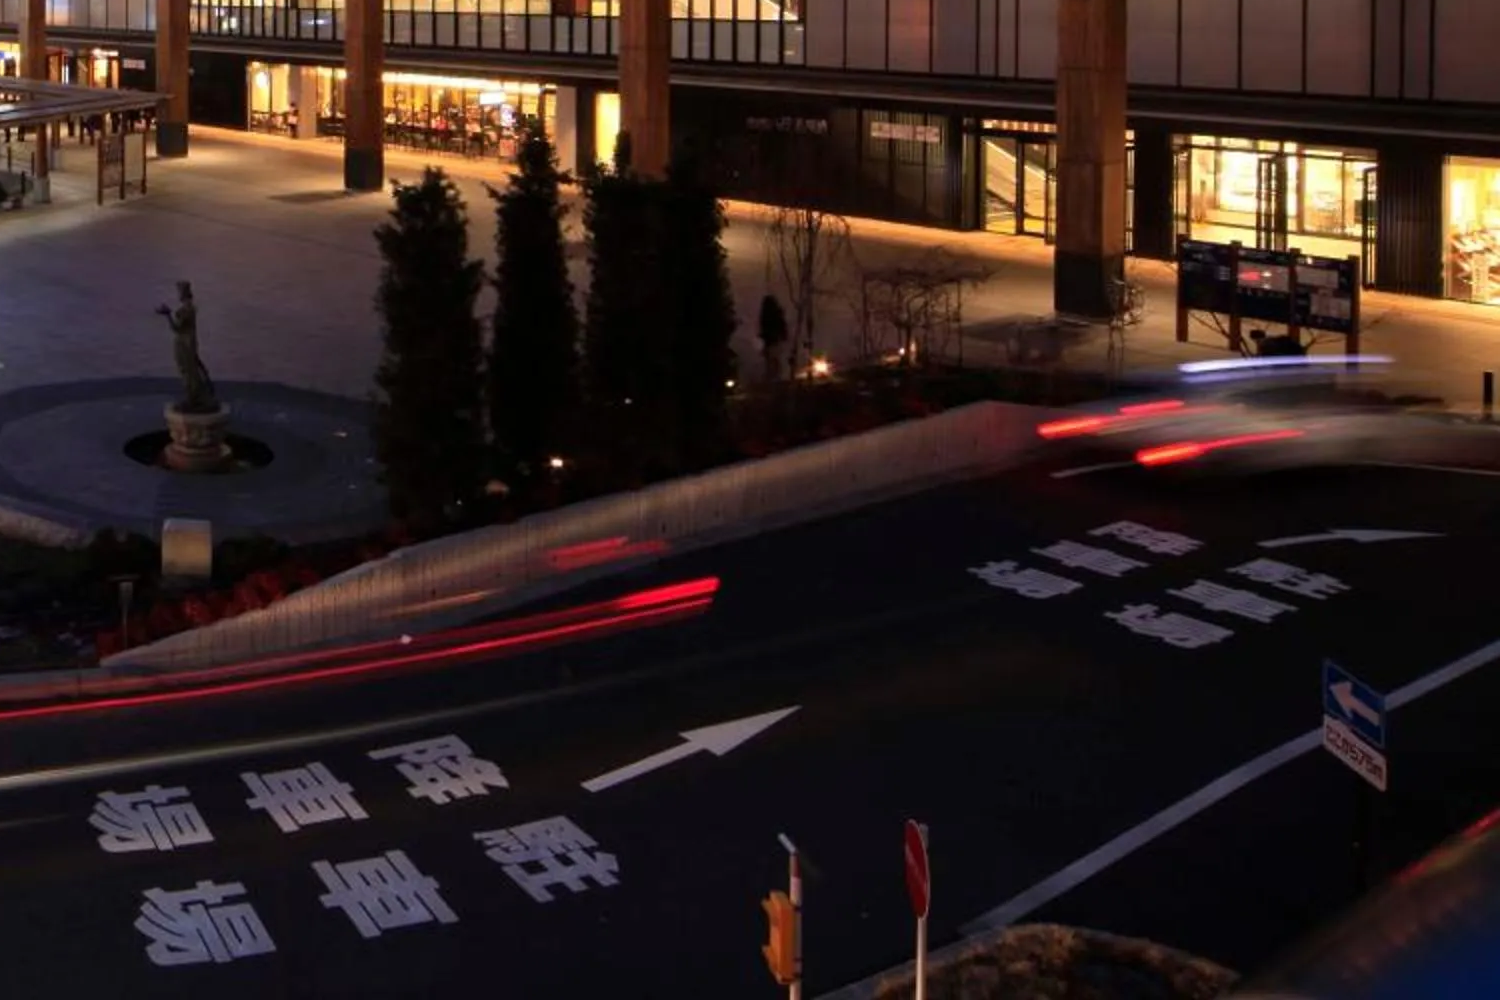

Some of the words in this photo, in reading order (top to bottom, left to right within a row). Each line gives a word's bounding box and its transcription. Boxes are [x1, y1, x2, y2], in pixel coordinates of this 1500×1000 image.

[89, 734, 509, 852] 降車場
[134, 816, 621, 966] 駐車場
